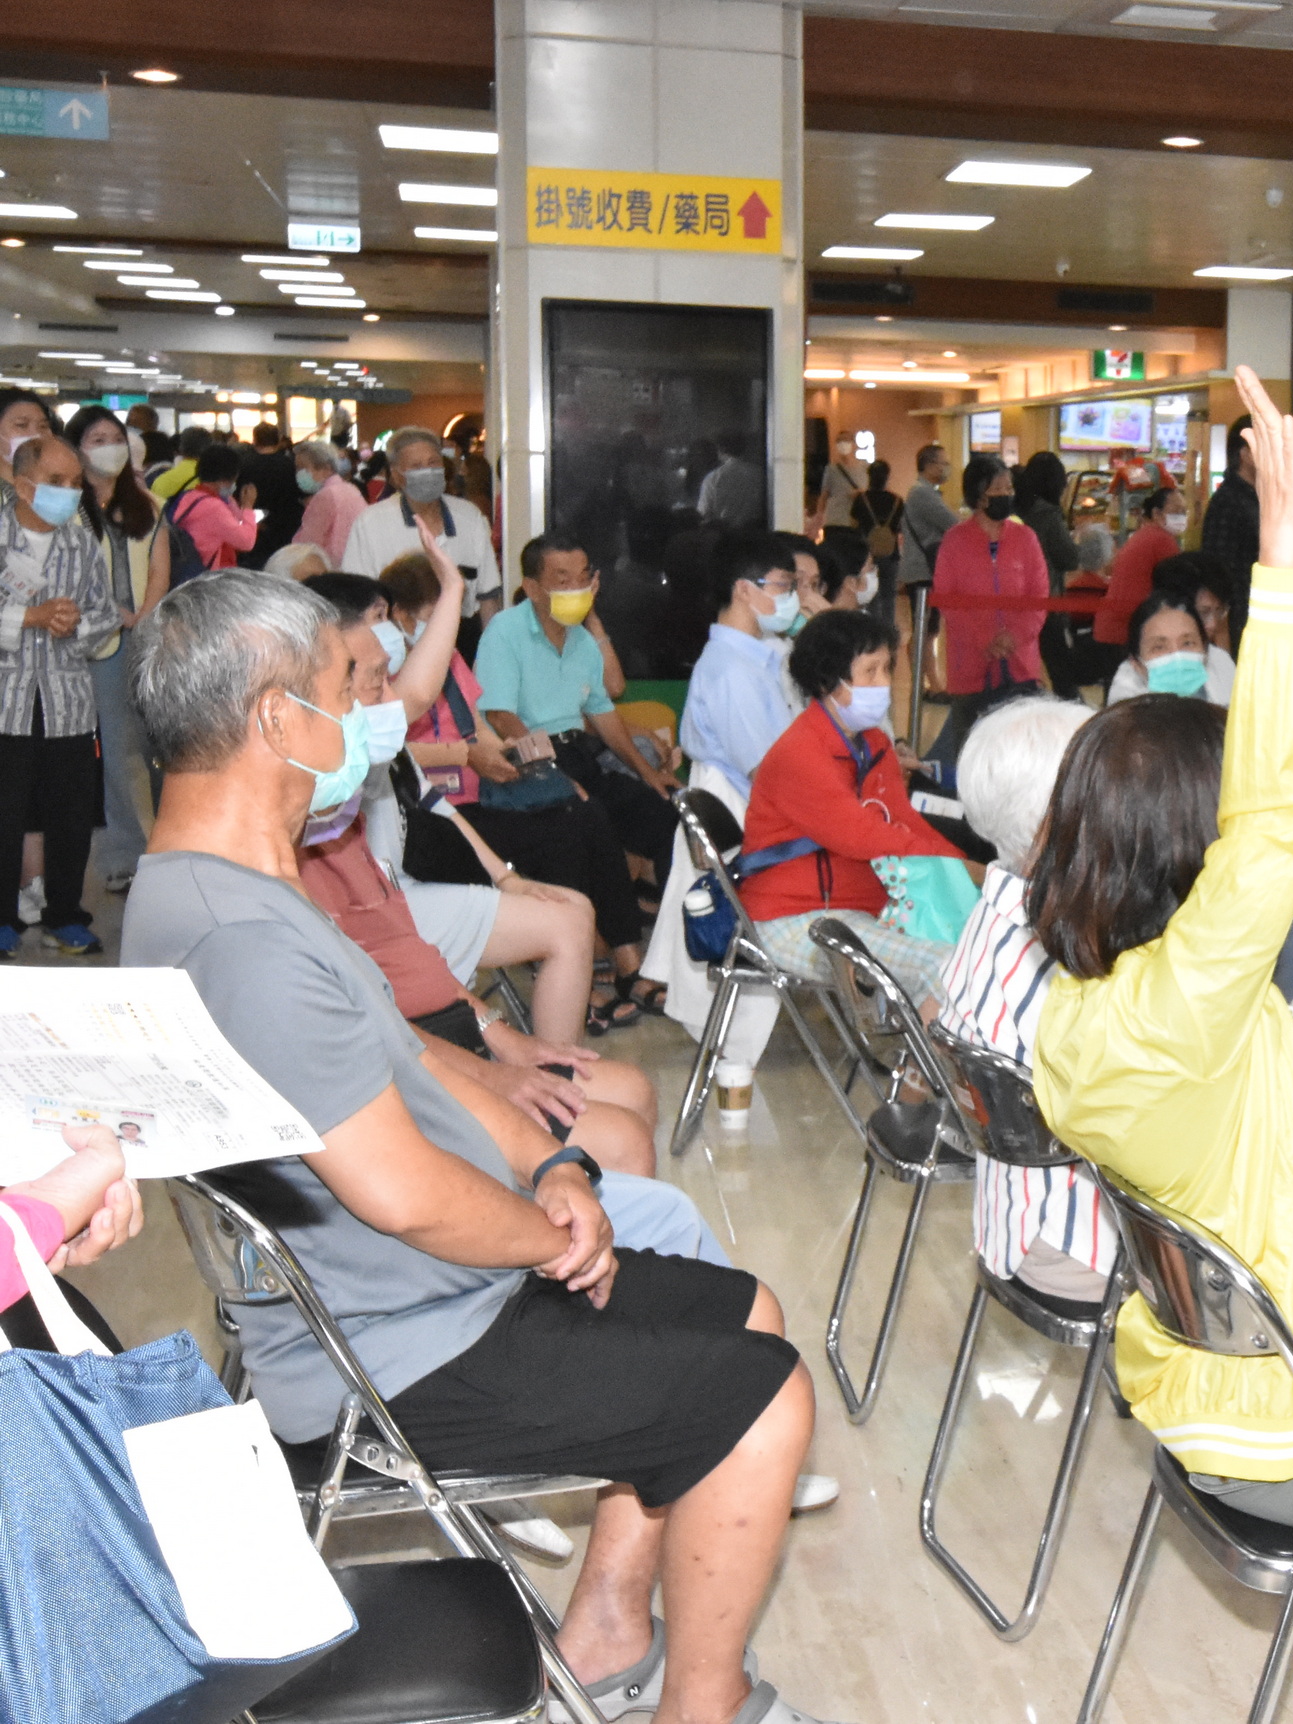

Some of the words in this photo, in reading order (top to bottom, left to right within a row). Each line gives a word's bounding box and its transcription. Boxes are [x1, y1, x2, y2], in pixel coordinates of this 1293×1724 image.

[535, 184, 730, 237] 掛號收費/藥局
